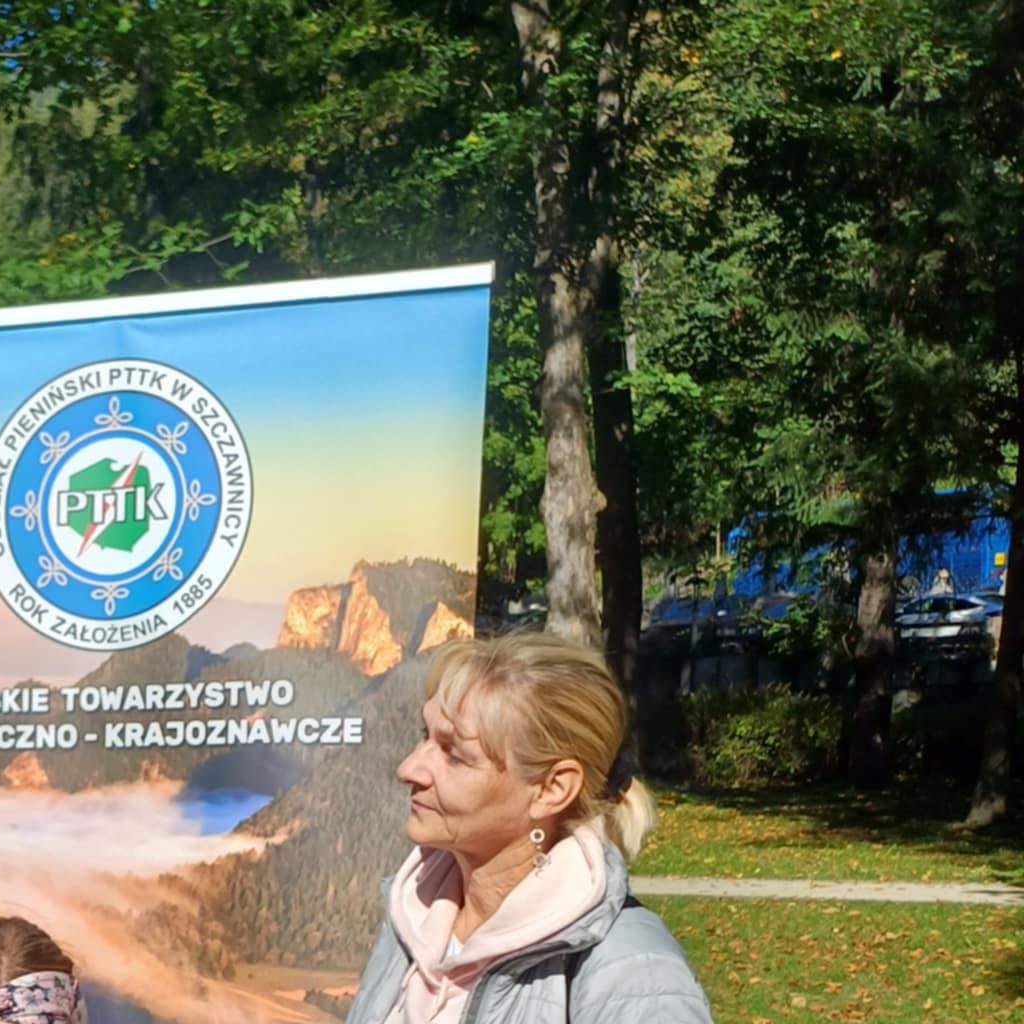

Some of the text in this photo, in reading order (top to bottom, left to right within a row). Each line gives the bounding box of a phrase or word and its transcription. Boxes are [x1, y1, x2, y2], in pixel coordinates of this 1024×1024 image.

[4, 370, 102, 452] PIENIŃSKI
[109, 367, 166, 391] PTTK
[171, 379, 193, 401] W
[191, 397, 246, 548] SZCZAWNICY
[56, 482, 168, 527] PTTK
[9, 574, 213, 644] ROK ZAŁOŻENIA 1885
[61, 679, 294, 714] TOWARZYSTWO
[105, 717, 363, 750] KRAJOZNAWCZE
